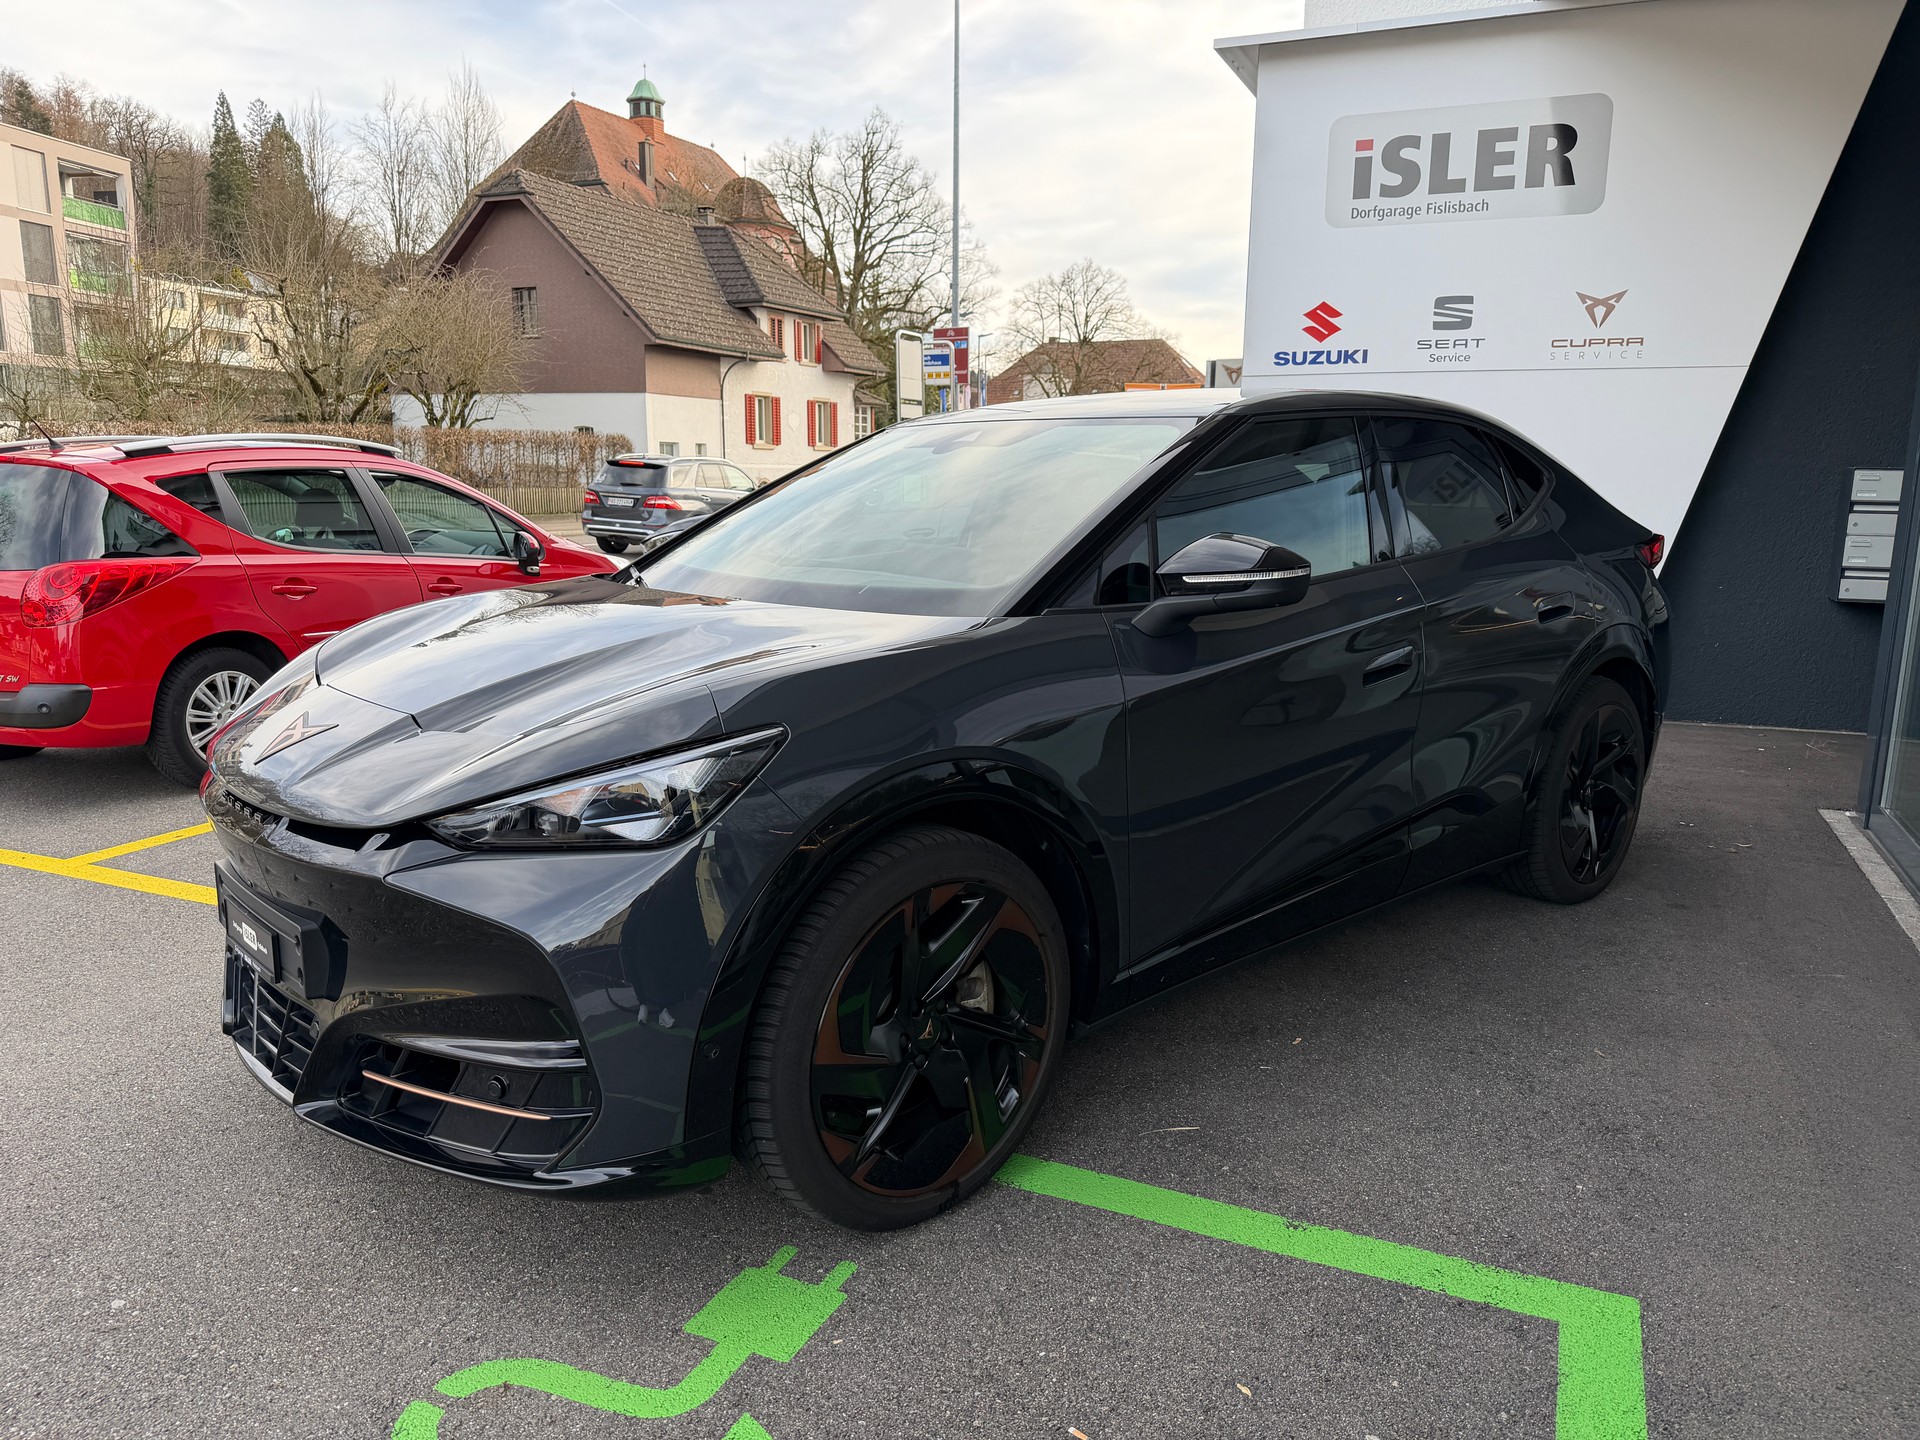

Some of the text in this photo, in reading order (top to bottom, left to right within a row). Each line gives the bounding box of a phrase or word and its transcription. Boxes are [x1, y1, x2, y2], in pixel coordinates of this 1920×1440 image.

[1351, 199, 1489, 221] Dorfgarage Fislisbach
[1417, 338, 1485, 349] SEAT
[1551, 337, 1644, 348] CUPRA
[1273, 349, 1368, 366] SUZUKI
[1429, 353, 1470, 362] Service
[1550, 350, 1643, 360] SERVICE
[6, 675, 20, 683] SW
